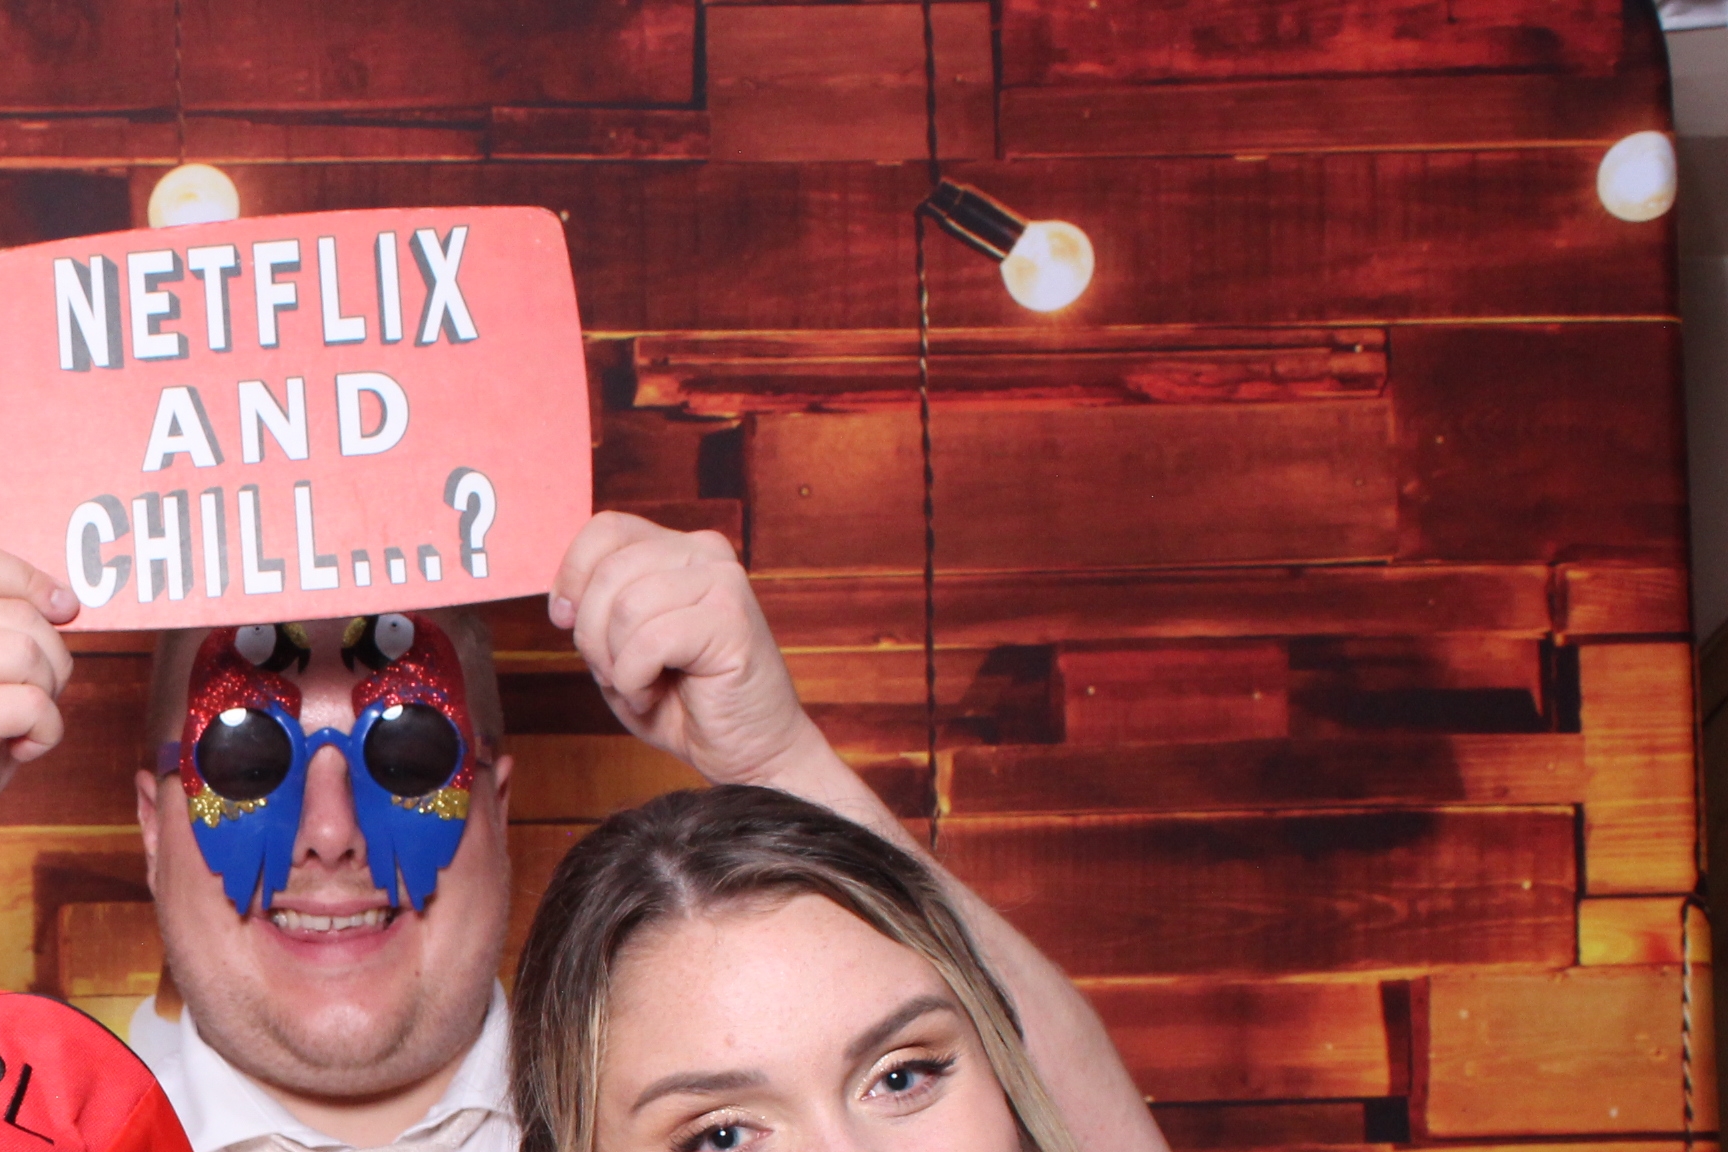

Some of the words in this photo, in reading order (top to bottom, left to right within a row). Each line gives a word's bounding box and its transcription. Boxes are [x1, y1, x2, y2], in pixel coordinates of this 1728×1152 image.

[53, 225, 480, 373] NETFLIX
[141, 371, 410, 473] AND
[65, 466, 498, 609] CHILL...?
